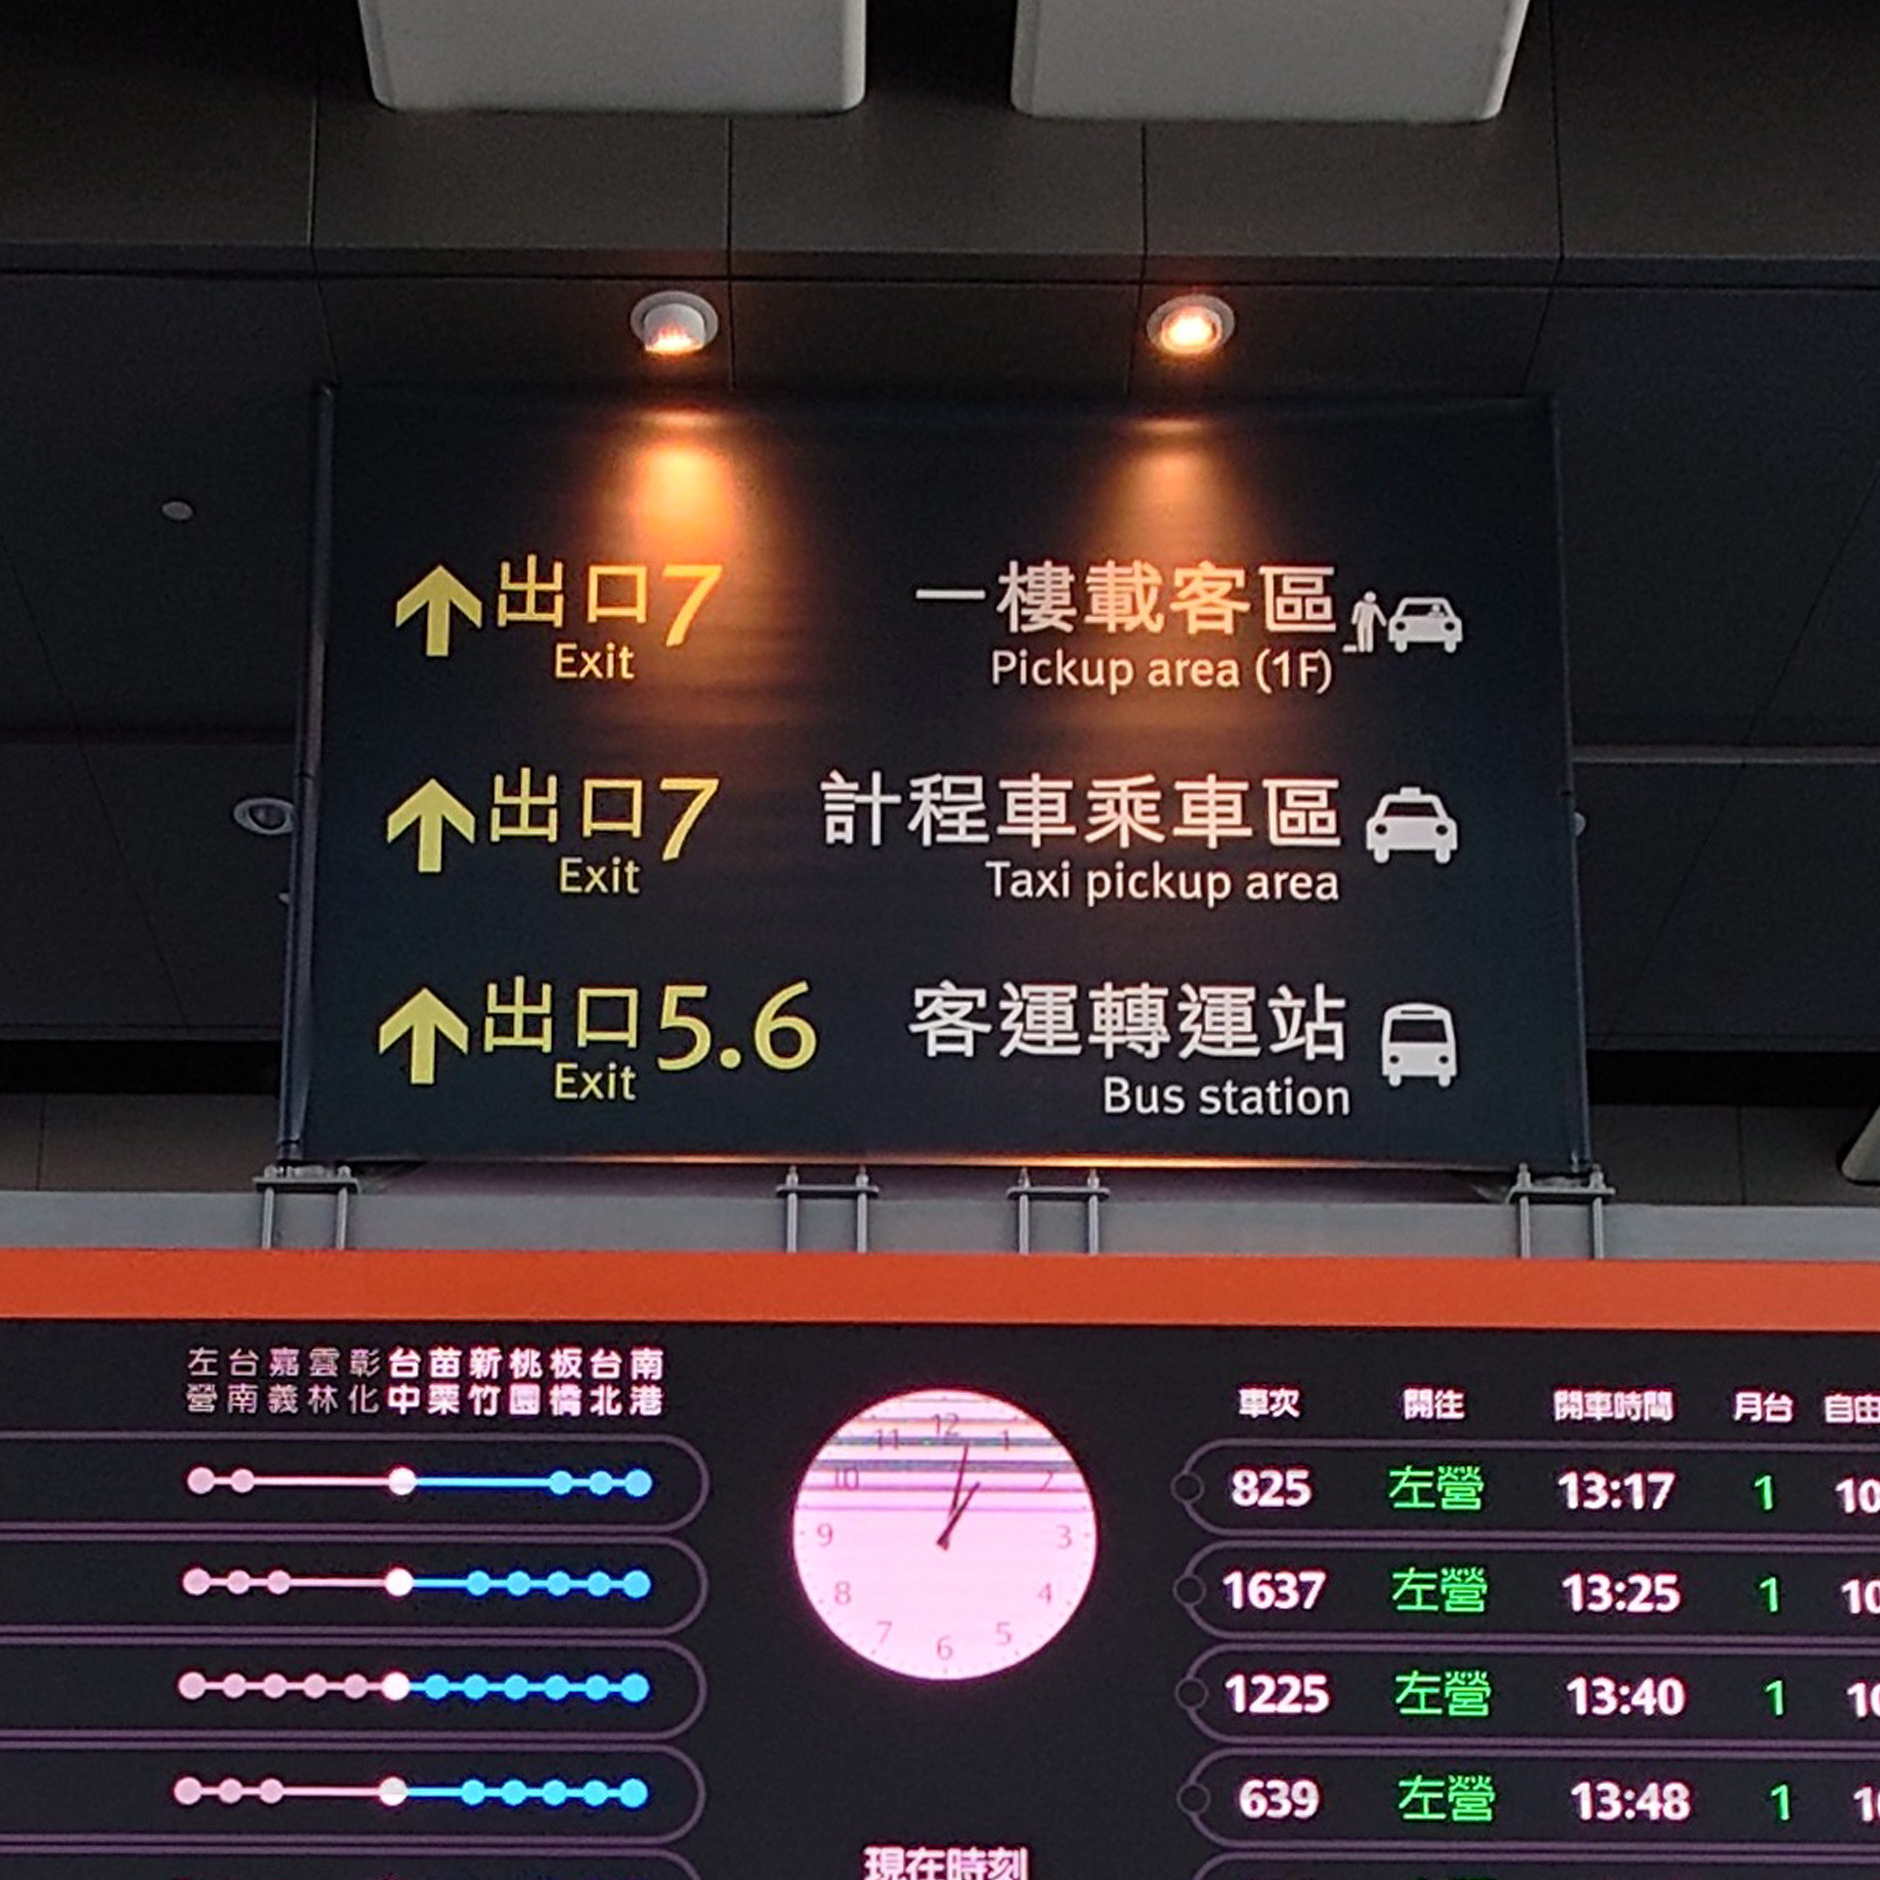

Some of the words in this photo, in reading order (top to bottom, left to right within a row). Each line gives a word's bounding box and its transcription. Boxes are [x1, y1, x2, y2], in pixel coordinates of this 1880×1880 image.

[496, 552, 724, 649] 出口7
[915, 558, 1338, 638] 一樓載客區
[555, 641, 635, 680] Exit
[992, 648, 1134, 696] Pickup
[1148, 658, 1240, 688] area
[1255, 648, 1332, 694] (1F)
[489, 766, 721, 863] 出口7
[820, 770, 1341, 850] 計程車乘車區
[560, 856, 640, 894] Exit
[985, 860, 1070, 898] Taxi
[1087, 860, 1232, 909] pickup
[1246, 871, 1339, 901] area
[484, 975, 818, 1074] 出口5.6
[908, 980, 1346, 1061] 客運轉運站
[555, 1062, 636, 1101] Exit
[1104, 1076, 1185, 1115] Bus
[1199, 1076, 1350, 1115] station
[1238, 1386, 1300, 1418] 車次
[1403, 1387, 1465, 1420] 開往
[1553, 1388, 1674, 1422] 開車時間
[1733, 1391, 1794, 1423] 月台
[1231, 1468, 1312, 1507] 825
[1388, 1464, 1485, 1511] 左營
[1557, 1470, 1676, 1510] 13:17
[1754, 1474, 1773, 1511] 1
[817, 1523, 833, 1547] 9
[1056, 1525, 1072, 1549] 3
[834, 1581, 851, 1604] 8
[1038, 1583, 1053, 1603] 4
[1222, 1570, 1327, 1610] 1637
[1392, 1566, 1488, 1613] 左營
[1562, 1572, 1681, 1613] 13:25
[1759, 1576, 1779, 1613] 1
[876, 1621, 893, 1643] 7
[937, 1636, 953, 1659] 6
[996, 1622, 1012, 1645] 5
[1225, 1673, 1330, 1714] 1225
[1395, 1669, 1492, 1717] 左營
[1566, 1676, 1686, 1716] 13:40
[1765, 1680, 1784, 1716] 1
[1238, 1778, 1320, 1819] 639
[1398, 1774, 1496, 1822] 左營
[1571, 1780, 1691, 1821] 13:48
[1770, 1784, 1790, 1821] 1
